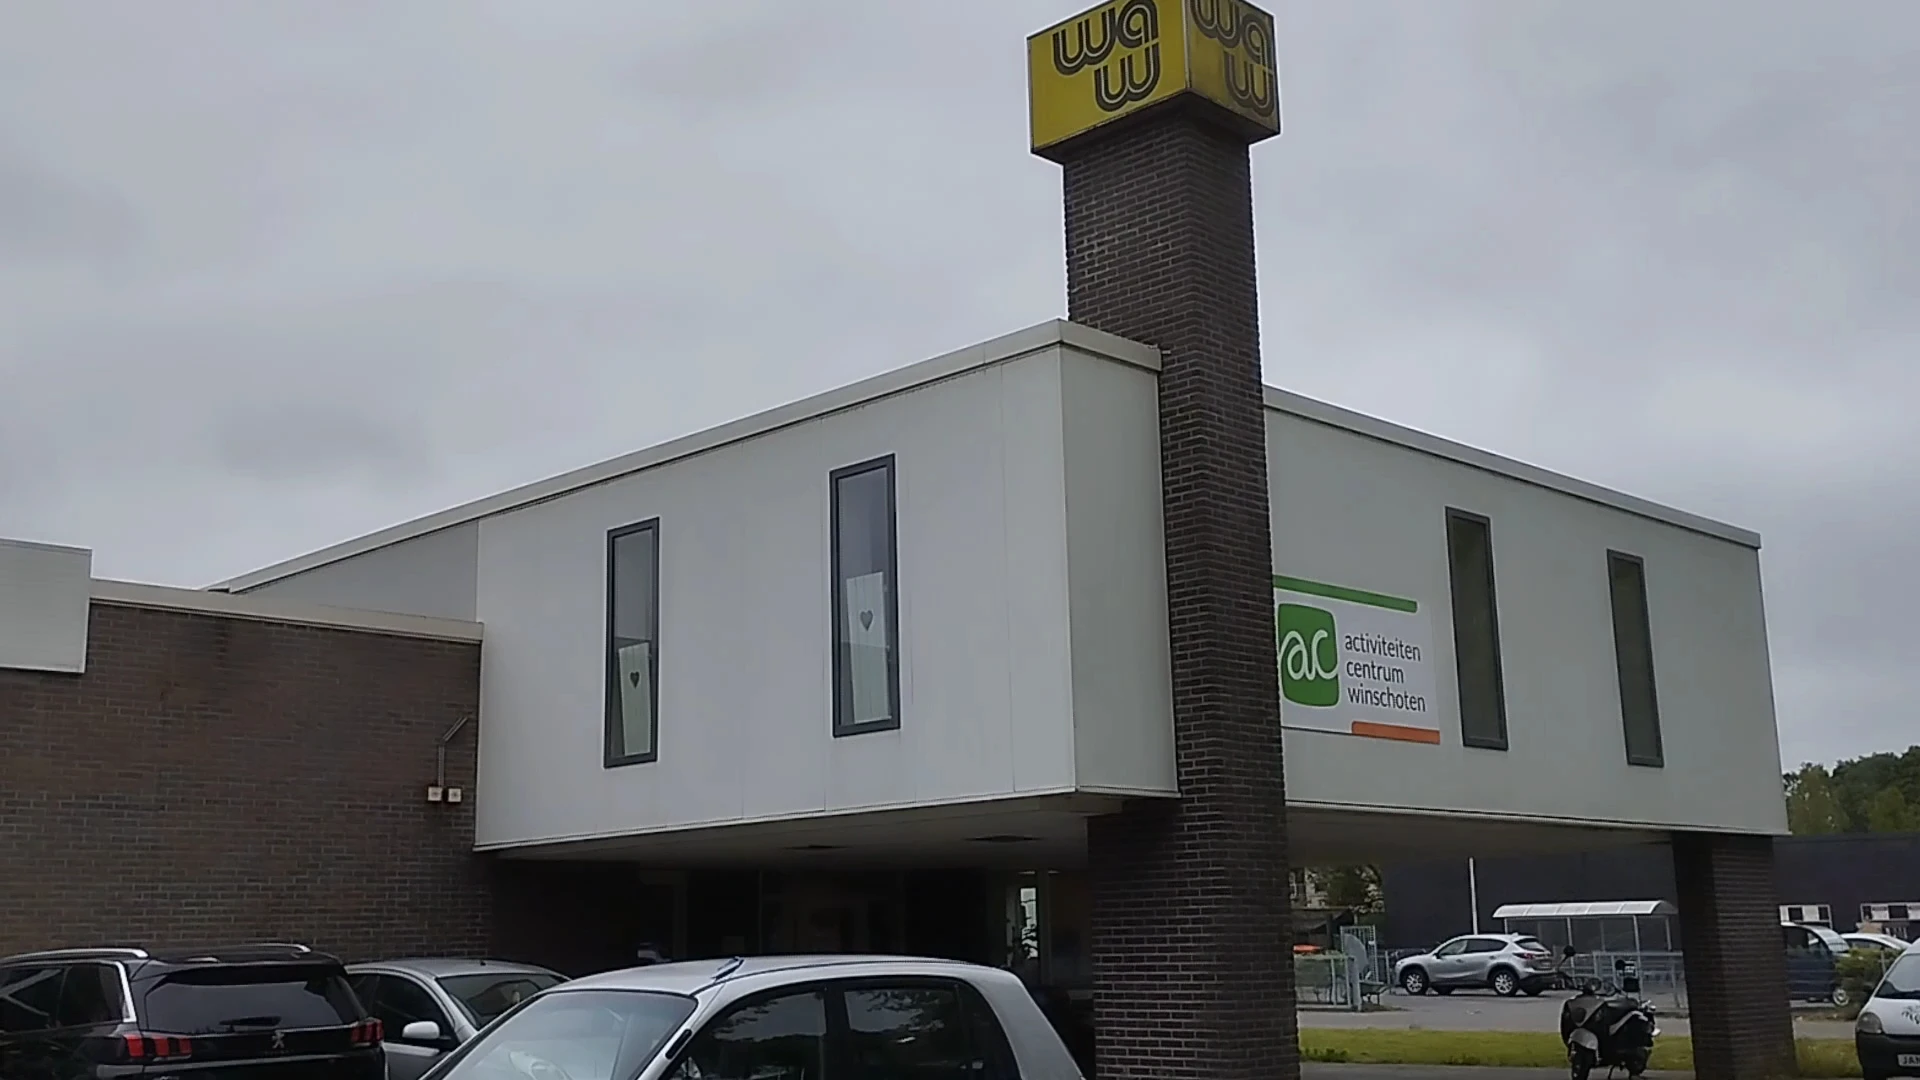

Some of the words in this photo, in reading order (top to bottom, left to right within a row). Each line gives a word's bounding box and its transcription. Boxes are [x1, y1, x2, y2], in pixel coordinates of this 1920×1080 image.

[1344, 633, 1421, 662] activiteiten
[1346, 660, 1405, 684] centrum
[1347, 683, 1426, 713] winschoten
